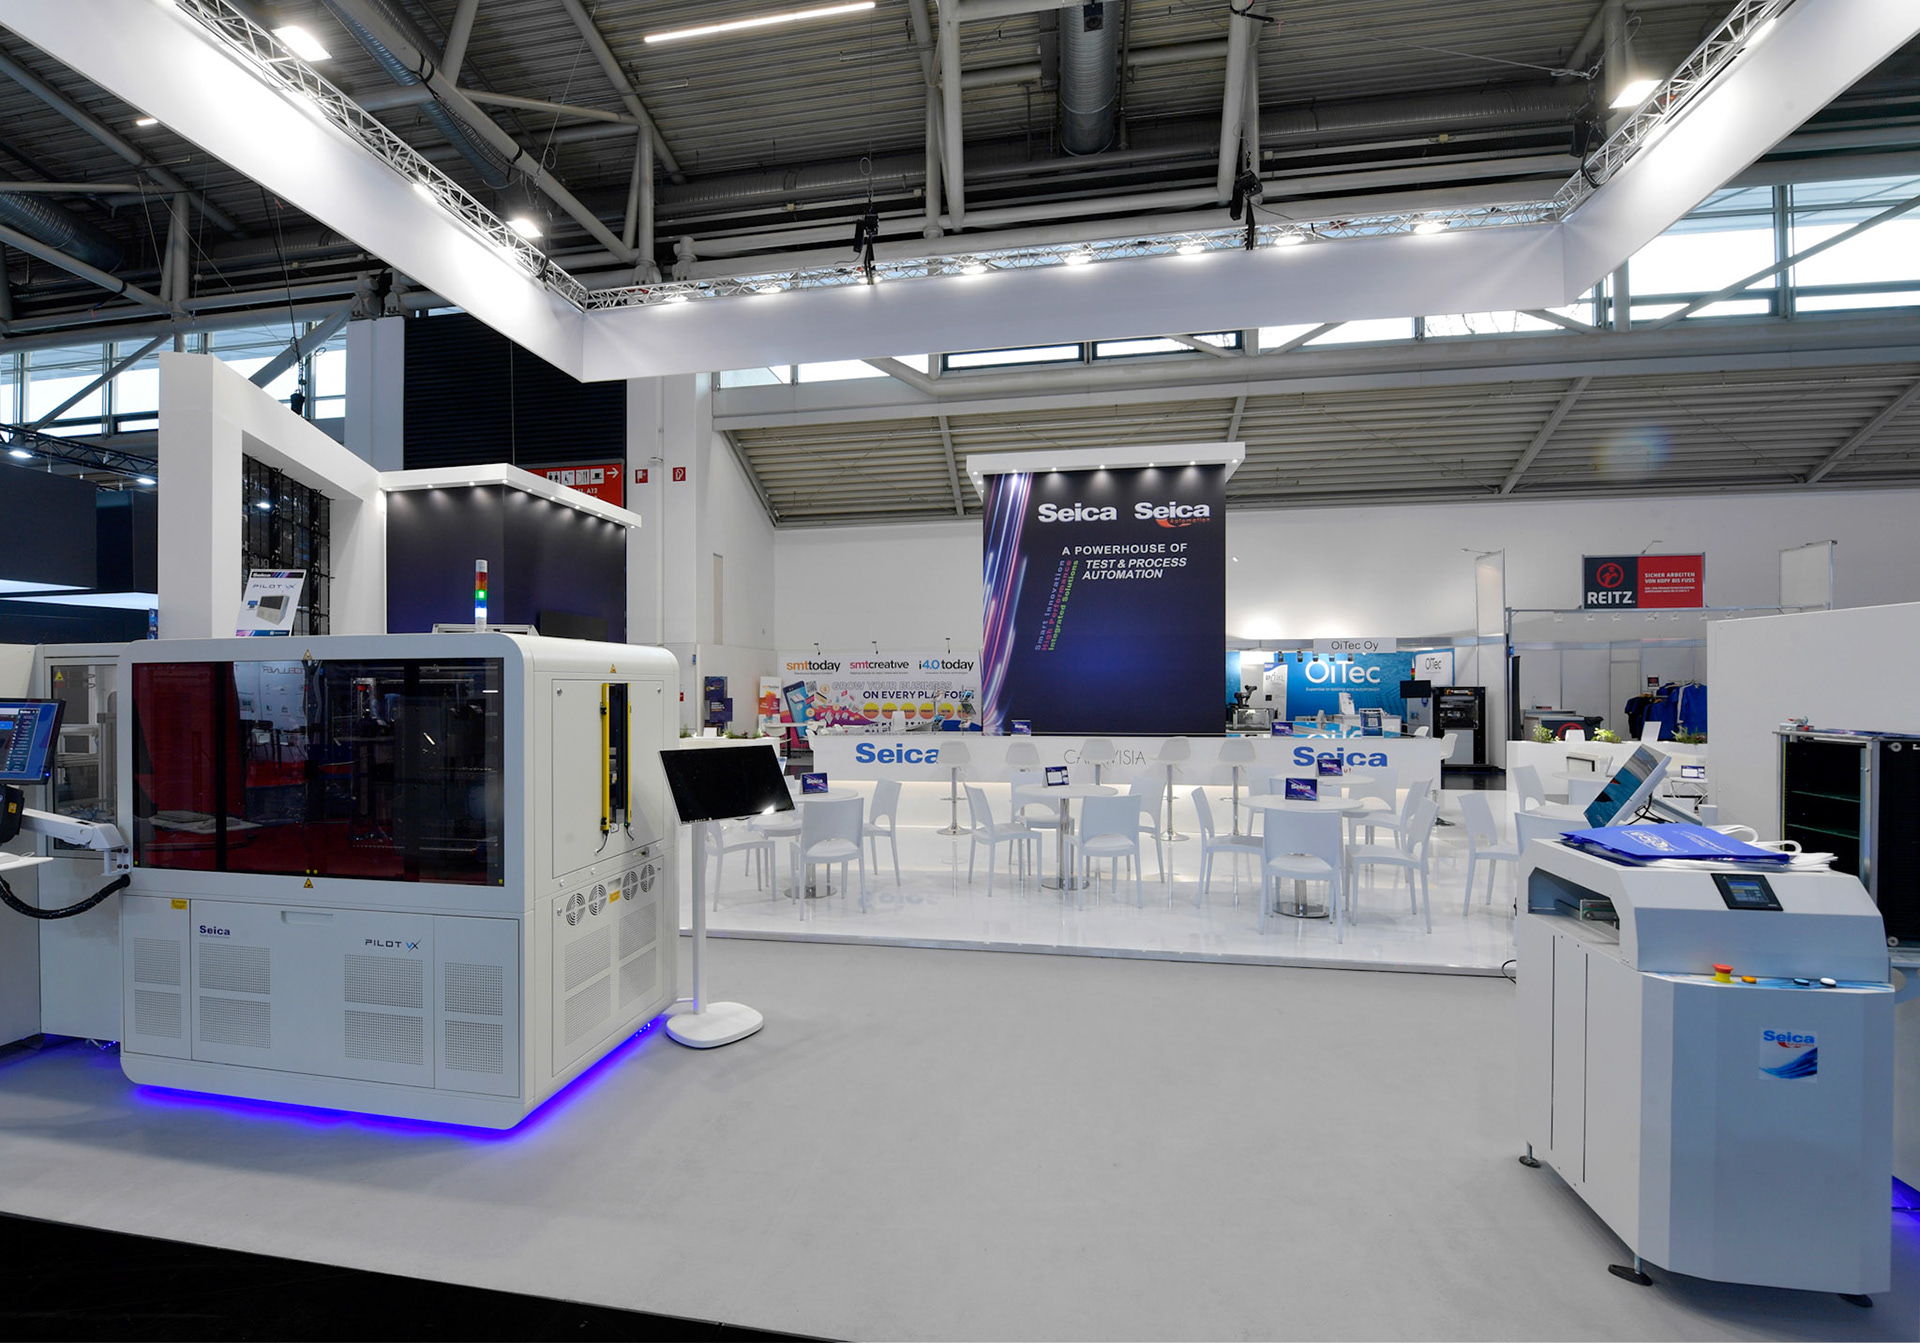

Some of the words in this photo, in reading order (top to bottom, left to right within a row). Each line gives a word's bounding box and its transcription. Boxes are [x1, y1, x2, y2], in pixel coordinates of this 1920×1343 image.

[1038, 502, 1117, 523] Seica
[1134, 501, 1210, 520] Seica
[1062, 547, 1070, 556] A
[1074, 544, 1166, 555] POWERHOUSE
[1170, 543, 1188, 552] OF
[1086, 559, 1116, 569] TEST
[1117, 559, 1126, 568] &
[1128, 558, 1187, 568] PROCESS
[1082, 569, 1164, 580] AUTOMATION
[1035, 620, 1048, 650] Smart
[1044, 560, 1065, 616] Innovation
[1042, 628, 1053, 651] High
[1048, 560, 1072, 624] Performance
[1048, 604, 1066, 651] Integrated
[1062, 560, 1078, 602] Solutions
[1331, 640, 1360, 650] OiTec
[1364, 640, 1379, 651] Oy
[786, 660, 840, 672] smttoday
[850, 660, 910, 669] smtcreative
[1305, 660, 1380, 684] OiTec
[867, 681, 896, 690] YOUR
[862, 691, 878, 699] ON
[882, 691, 916, 699] EVERY
[199, 925, 230, 935] Seica
[365, 939, 402, 948] PILOT
[1763, 1030, 1815, 1044] Seica
